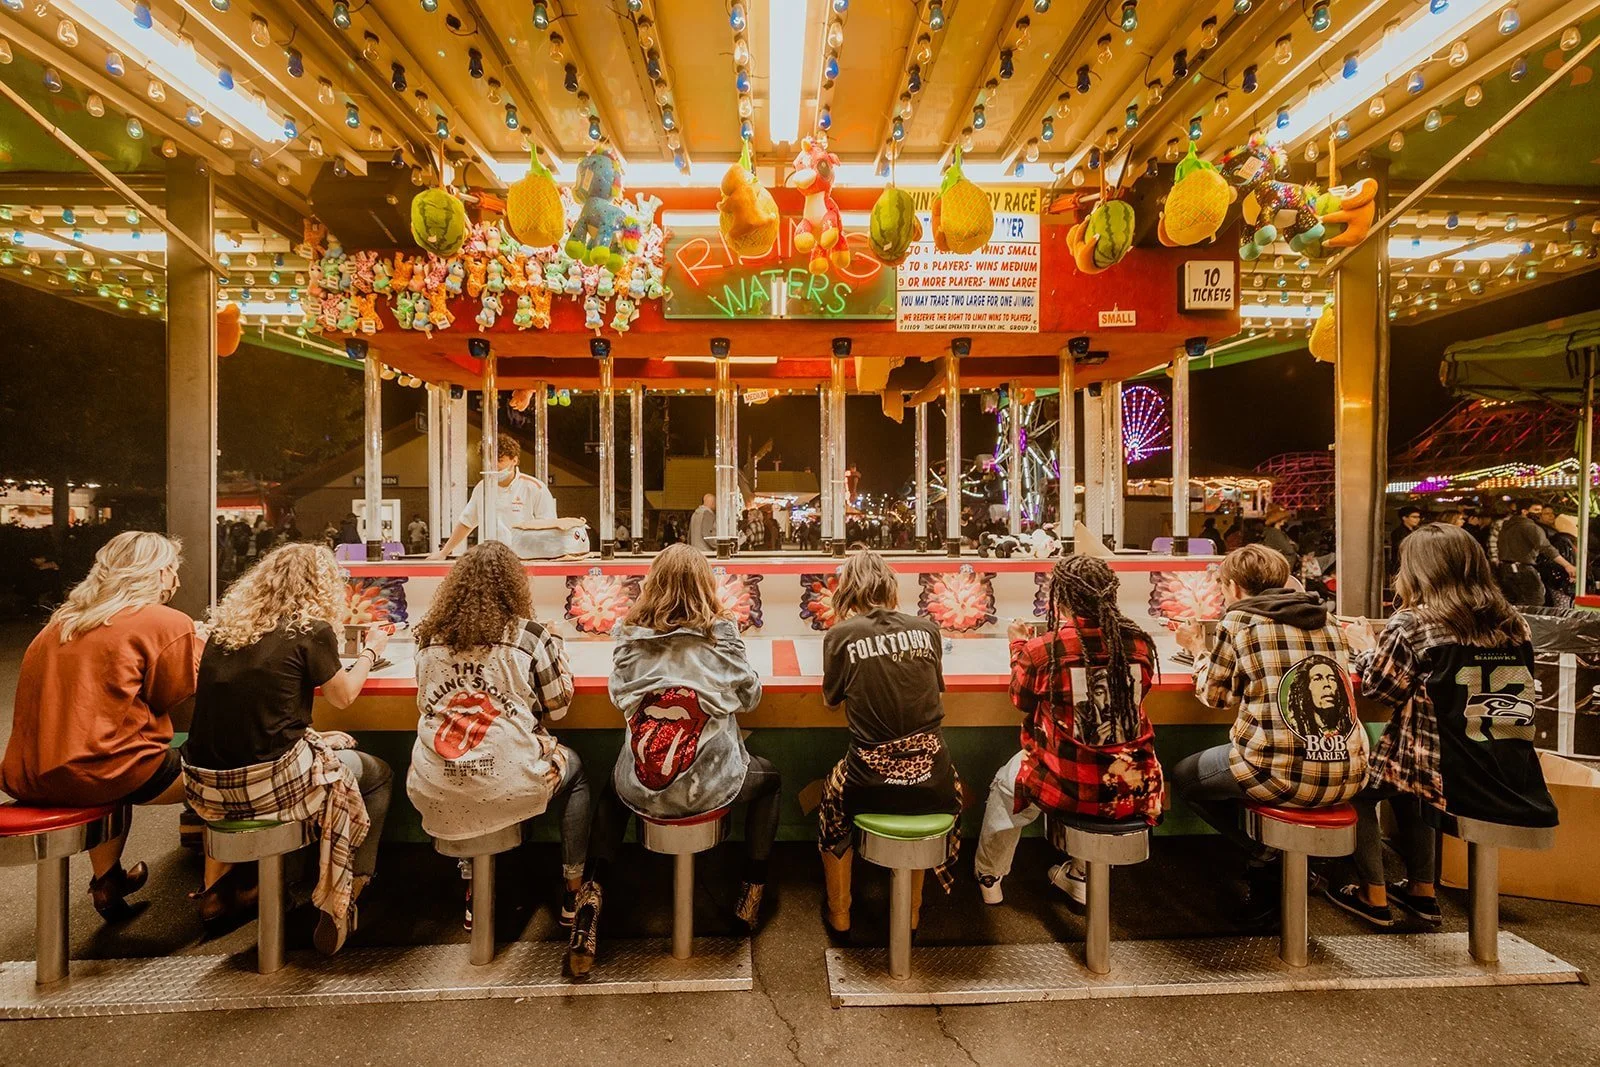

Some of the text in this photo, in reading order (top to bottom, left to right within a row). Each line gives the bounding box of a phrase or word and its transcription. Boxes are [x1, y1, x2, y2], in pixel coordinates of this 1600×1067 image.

[1004, 192, 1037, 212] RACE
[980, 244, 1005, 255] WINS
[1007, 246, 1037, 256] SMALL
[909, 261, 920, 270] TO
[923, 262, 928, 270] 8
[976, 261, 999, 271] WINS
[1001, 262, 1037, 272] MEDIUM
[899, 277, 905, 287] 9
[908, 277, 920, 287] OR
[922, 277, 946, 287] MORE
[989, 277, 1009, 287] WINS
[1012, 277, 1037, 288] LARGE
[1204, 268, 1221, 287] 10
[707, 268, 853, 318] WATERS
[1192, 288, 1231, 302] TICKETS
[901, 295, 913, 307] YOU
[915, 295, 928, 307] MAY
[930, 295, 949, 307] TRADE
[951, 295, 965, 307] TWO
[966, 295, 985, 307] LARGE
[987, 295, 998, 307] FOR
[1000, 295, 1012, 307] ONE
[904, 313, 912, 321] WE
[913, 313, 935, 321] RESERVE
[937, 313, 947, 321] THE
[948, 313, 964, 321] RIGHT
[965, 313, 971, 321] TO
[973, 313, 987, 321] LIMIT
[1003, 313, 1009, 321] TO
[1010, 313, 1031, 322] PLAYERS
[1101, 313, 1134, 324] SMALL
[847, 629, 934, 664] FOLKTOWN
[451, 663, 485, 675] THE
[1455, 665, 1536, 742] 12
[1305, 734, 1346, 752] BOB
[1306, 751, 1348, 760] MARLEY
